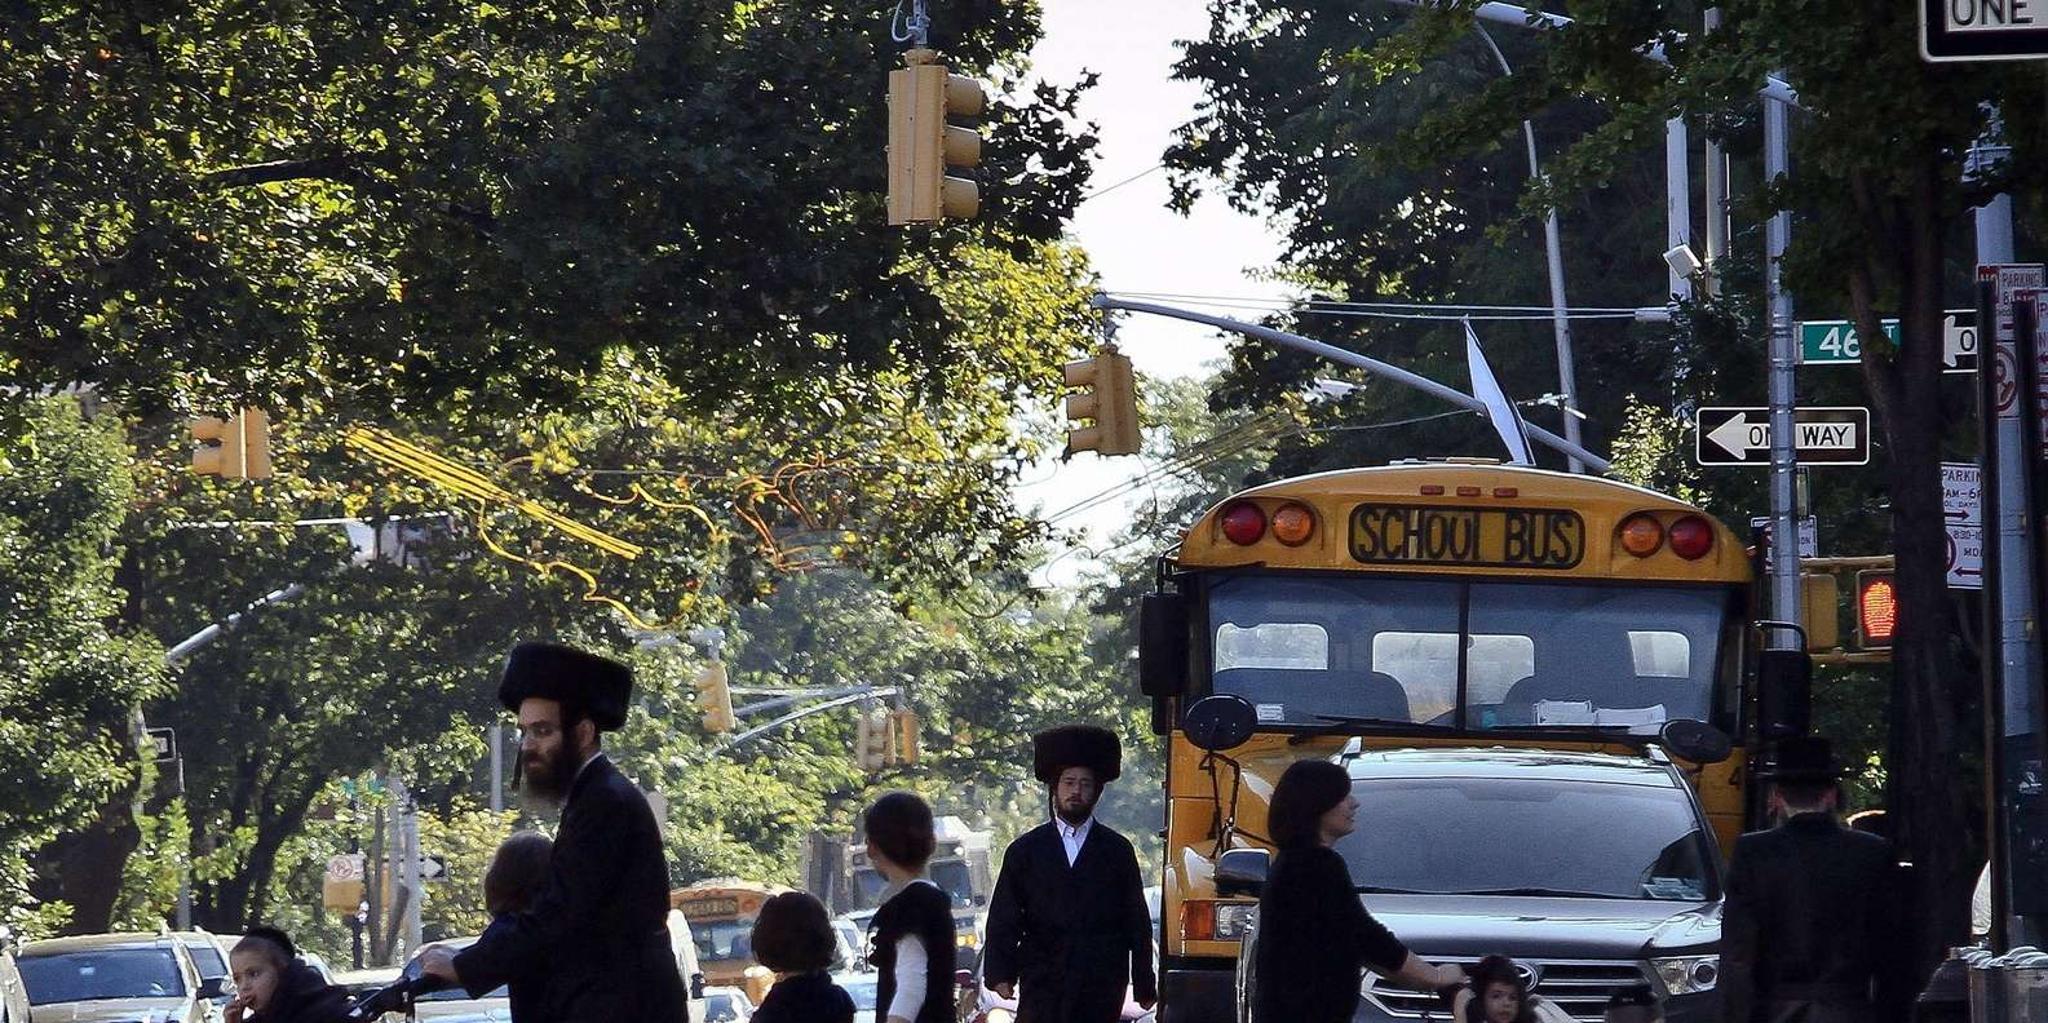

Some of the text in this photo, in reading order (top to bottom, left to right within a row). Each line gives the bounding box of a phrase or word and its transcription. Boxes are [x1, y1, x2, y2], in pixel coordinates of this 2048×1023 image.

[1952, 0, 2034, 26] ONE
[2002, 272, 2041, 288] PARKING
[1819, 326, 1861, 358] 46
[1802, 425, 1849, 446] WAY
[1942, 469, 1981, 481] PARKIN
[1505, 509, 1573, 565] BUS
